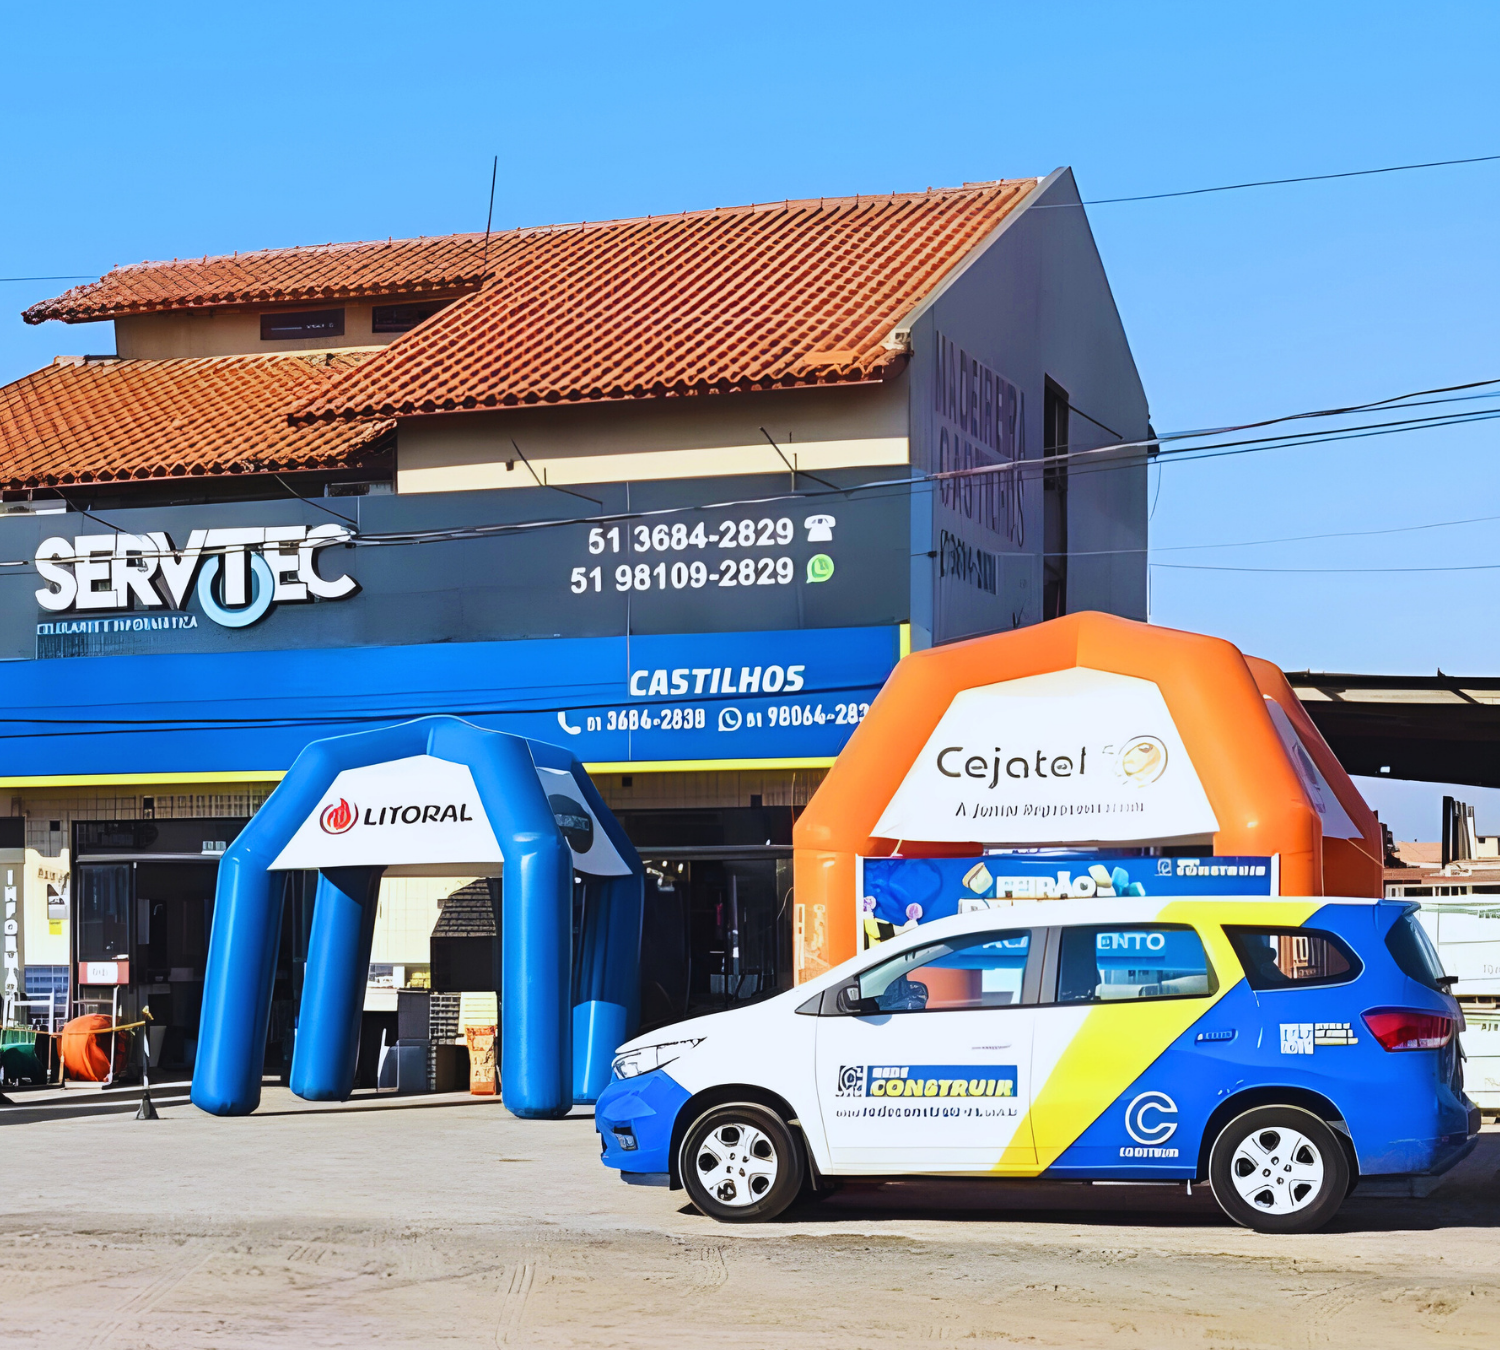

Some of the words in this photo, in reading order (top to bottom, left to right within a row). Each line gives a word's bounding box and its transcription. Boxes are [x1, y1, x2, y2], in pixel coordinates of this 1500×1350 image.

[588, 526, 620, 554] 51
[633, 517, 795, 552] 3684-2829
[570, 566, 603, 594] 51
[614, 556, 795, 592] 98109-2829
[630, 665, 805, 697] CASTILHOS
[936, 746, 1087, 790] Cejatel
[364, 803, 473, 826] LITORAL
